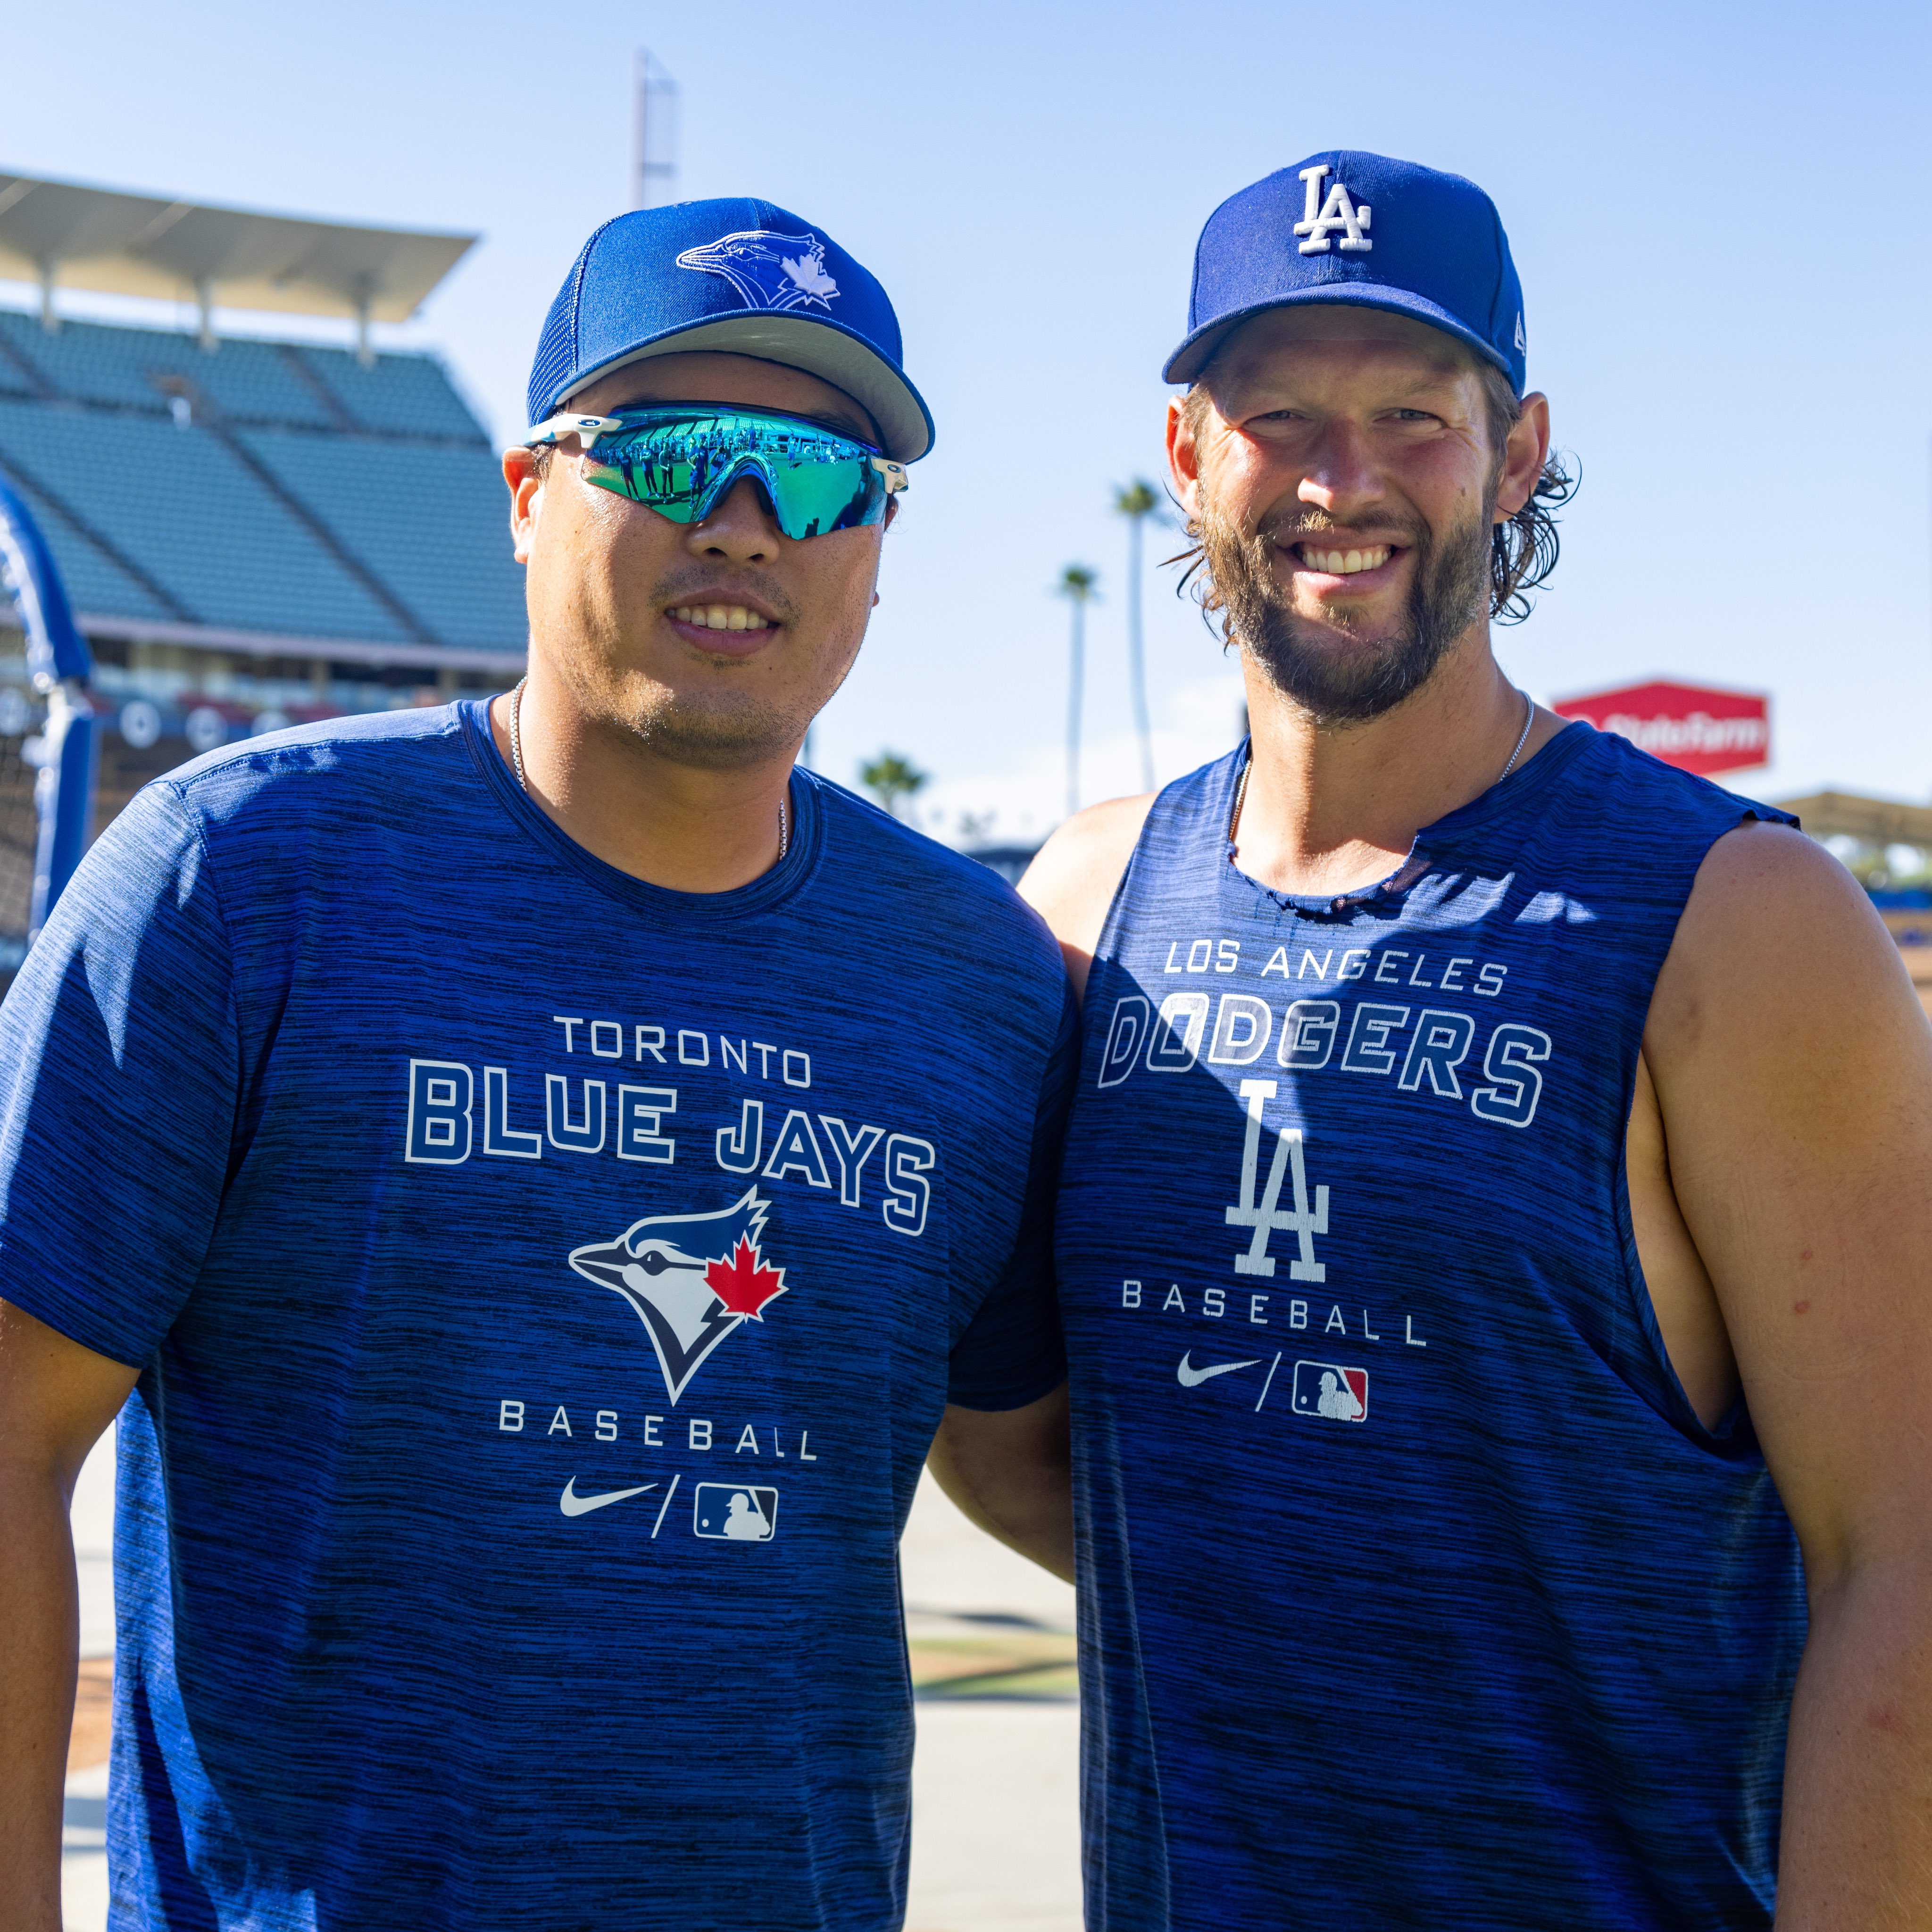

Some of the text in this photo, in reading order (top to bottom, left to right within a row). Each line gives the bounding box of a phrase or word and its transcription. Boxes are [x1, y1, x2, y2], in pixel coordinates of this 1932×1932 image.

[1294, 164, 1373, 254] LA
[1164, 939, 1507, 997] LOS ANGELES
[554, 1016, 810, 1088] TORONTO
[1098, 992, 1551, 1128] DODGERS
[405, 1058, 935, 1236] BLUE JAYS
[1226, 1080, 1329, 1282] LA
[1122, 1280, 1426, 1346] BASEBALL
[499, 1400, 817, 1461] BASEBALL
